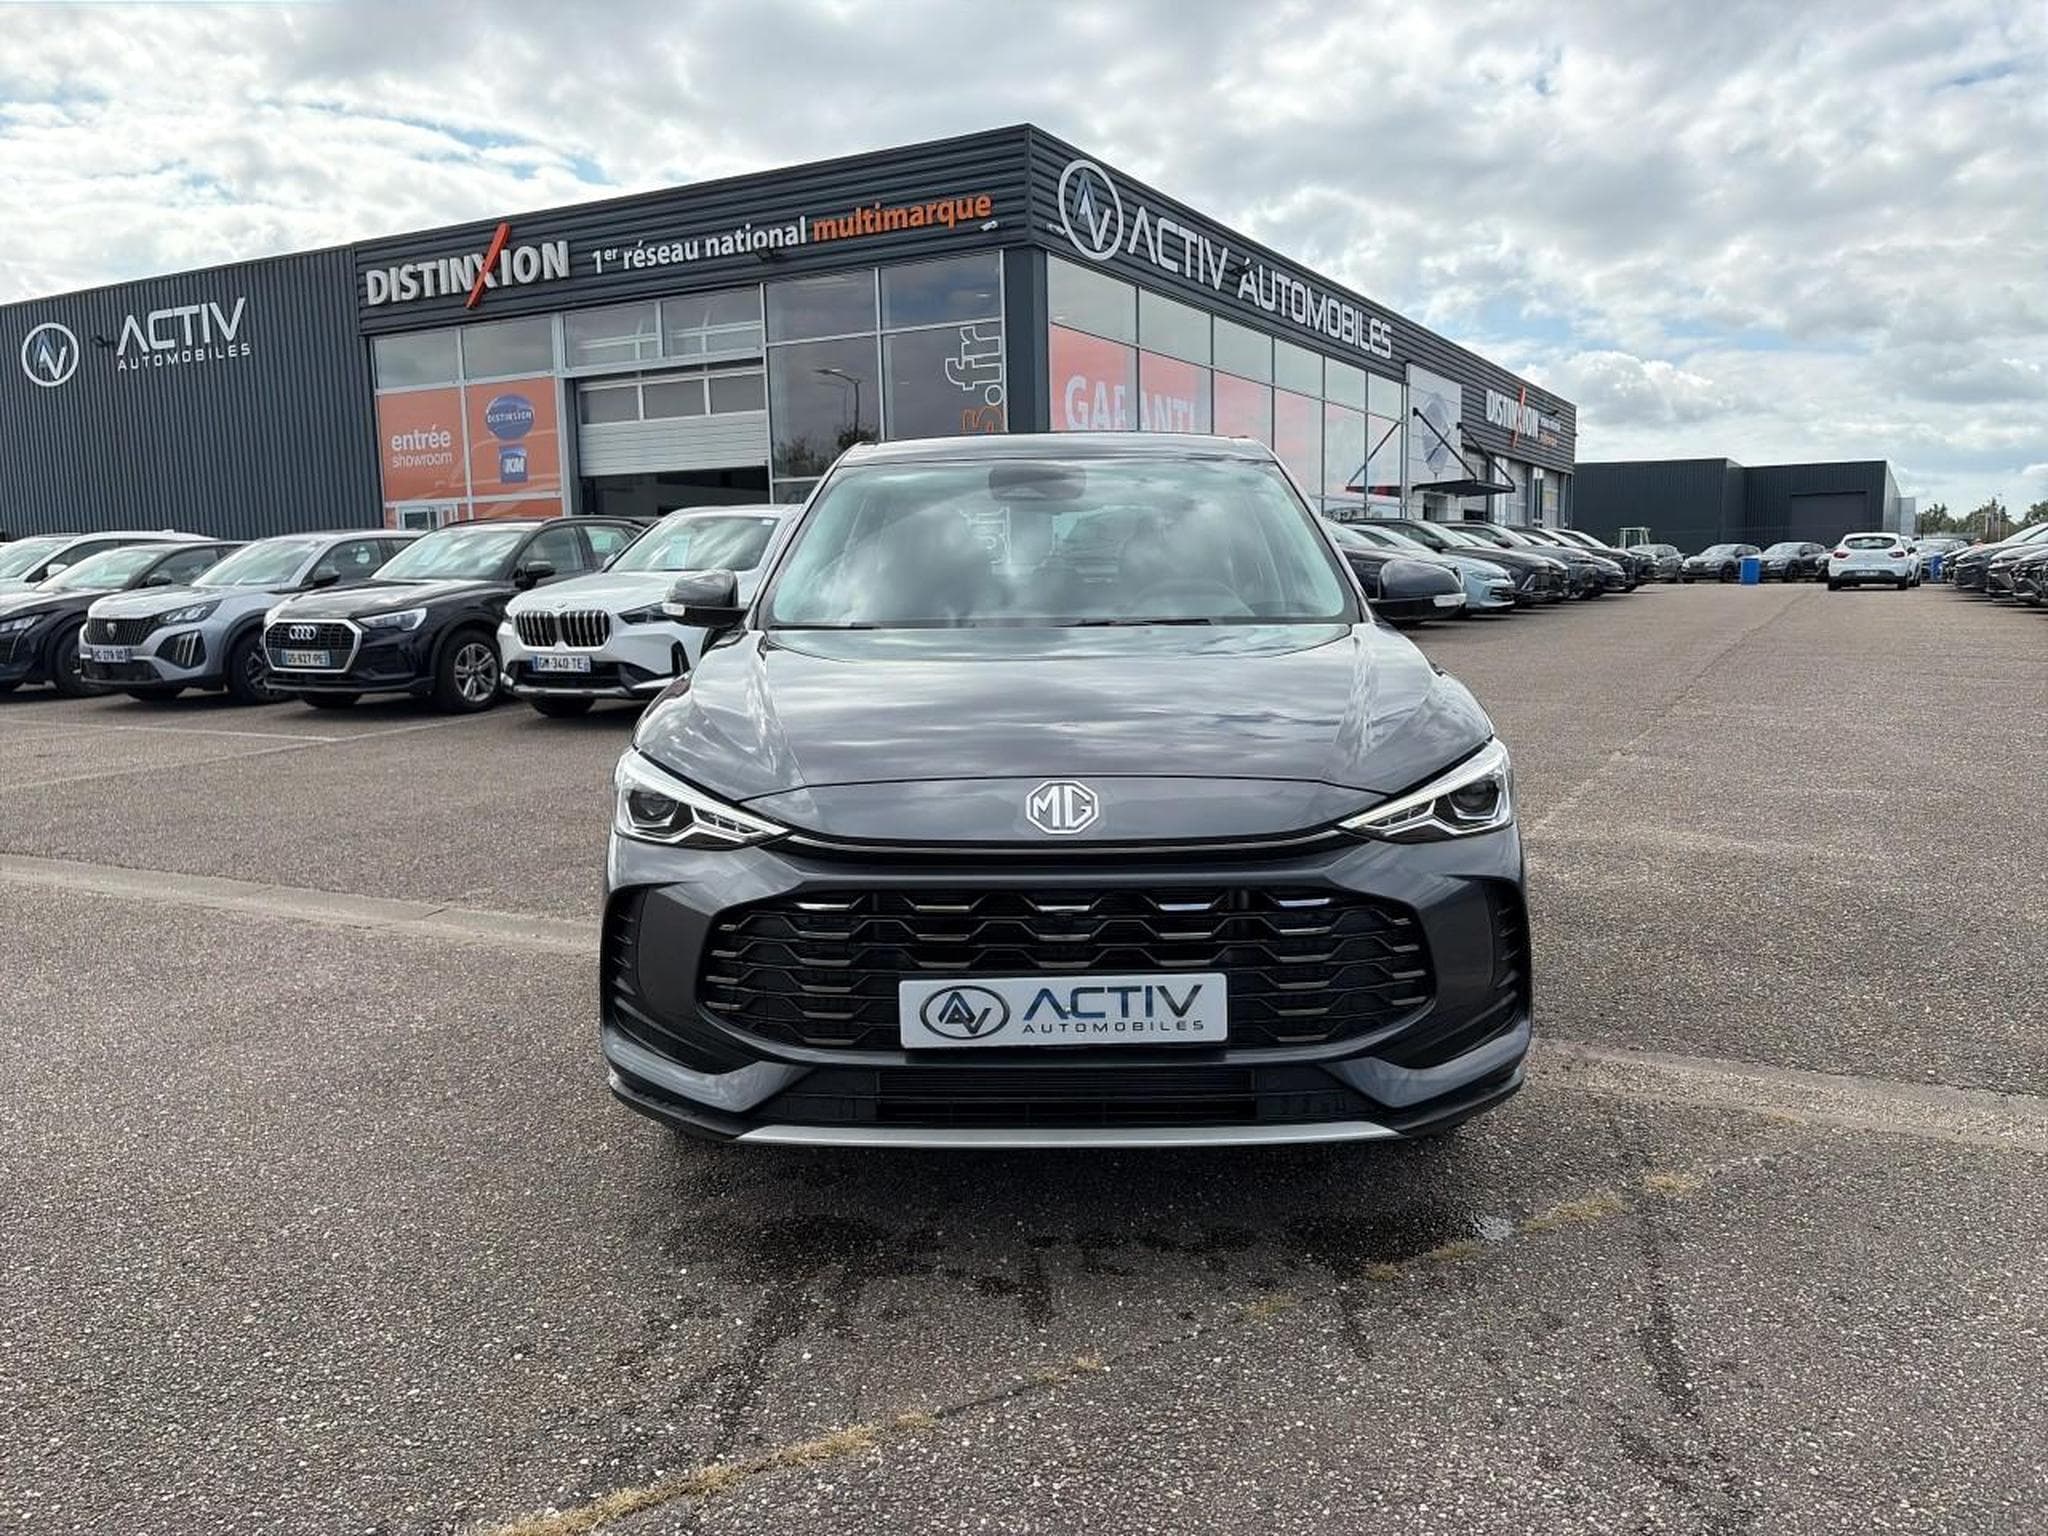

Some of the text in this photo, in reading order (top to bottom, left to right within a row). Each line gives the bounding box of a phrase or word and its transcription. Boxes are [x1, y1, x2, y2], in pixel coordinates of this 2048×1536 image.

[592, 194, 992, 273] 1er réseau national multimarque
[365, 224, 571, 308] DISTINXION
[1127, 205, 1392, 360] ACTIV AUTOMOBILES
[117, 297, 246, 356] ACTIV
[117, 343, 251, 372] AUTOMOBILES
[391, 424, 452, 451] entrée
[392, 453, 453, 469] showroom
[1033, 785, 1092, 827] MG
[1023, 984, 1203, 1021] ACTIV
[1022, 1020, 1204, 1034] AUTOMOBILES
